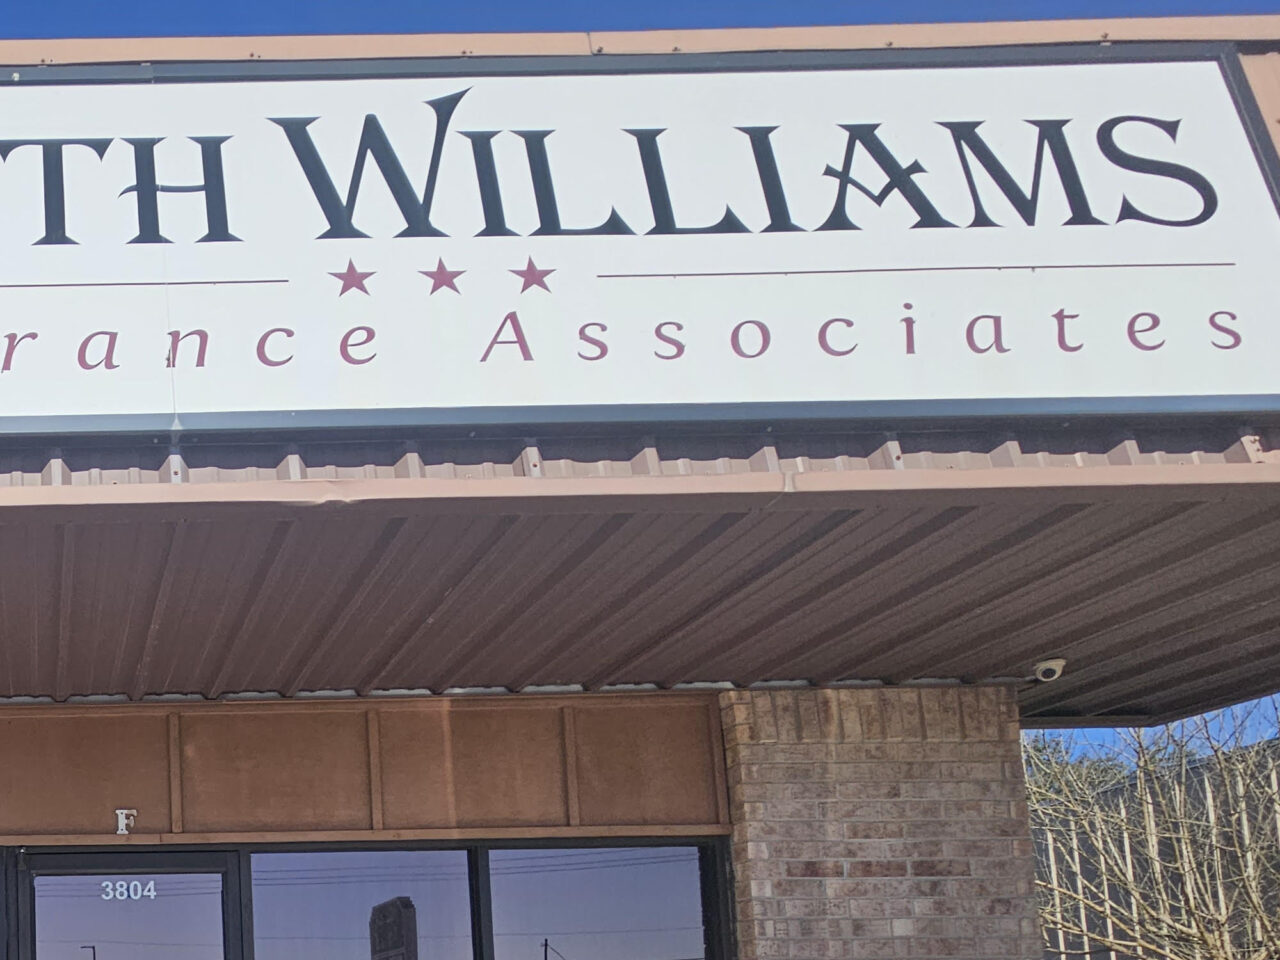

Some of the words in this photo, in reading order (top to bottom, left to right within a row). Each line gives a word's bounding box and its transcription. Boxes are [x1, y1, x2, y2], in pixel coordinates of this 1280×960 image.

[266, 86, 1219, 239] WILLIAMS
[480, 302, 1243, 363] Associates
[115, 809, 138, 835] F
[101, 880, 157, 900] 3804
